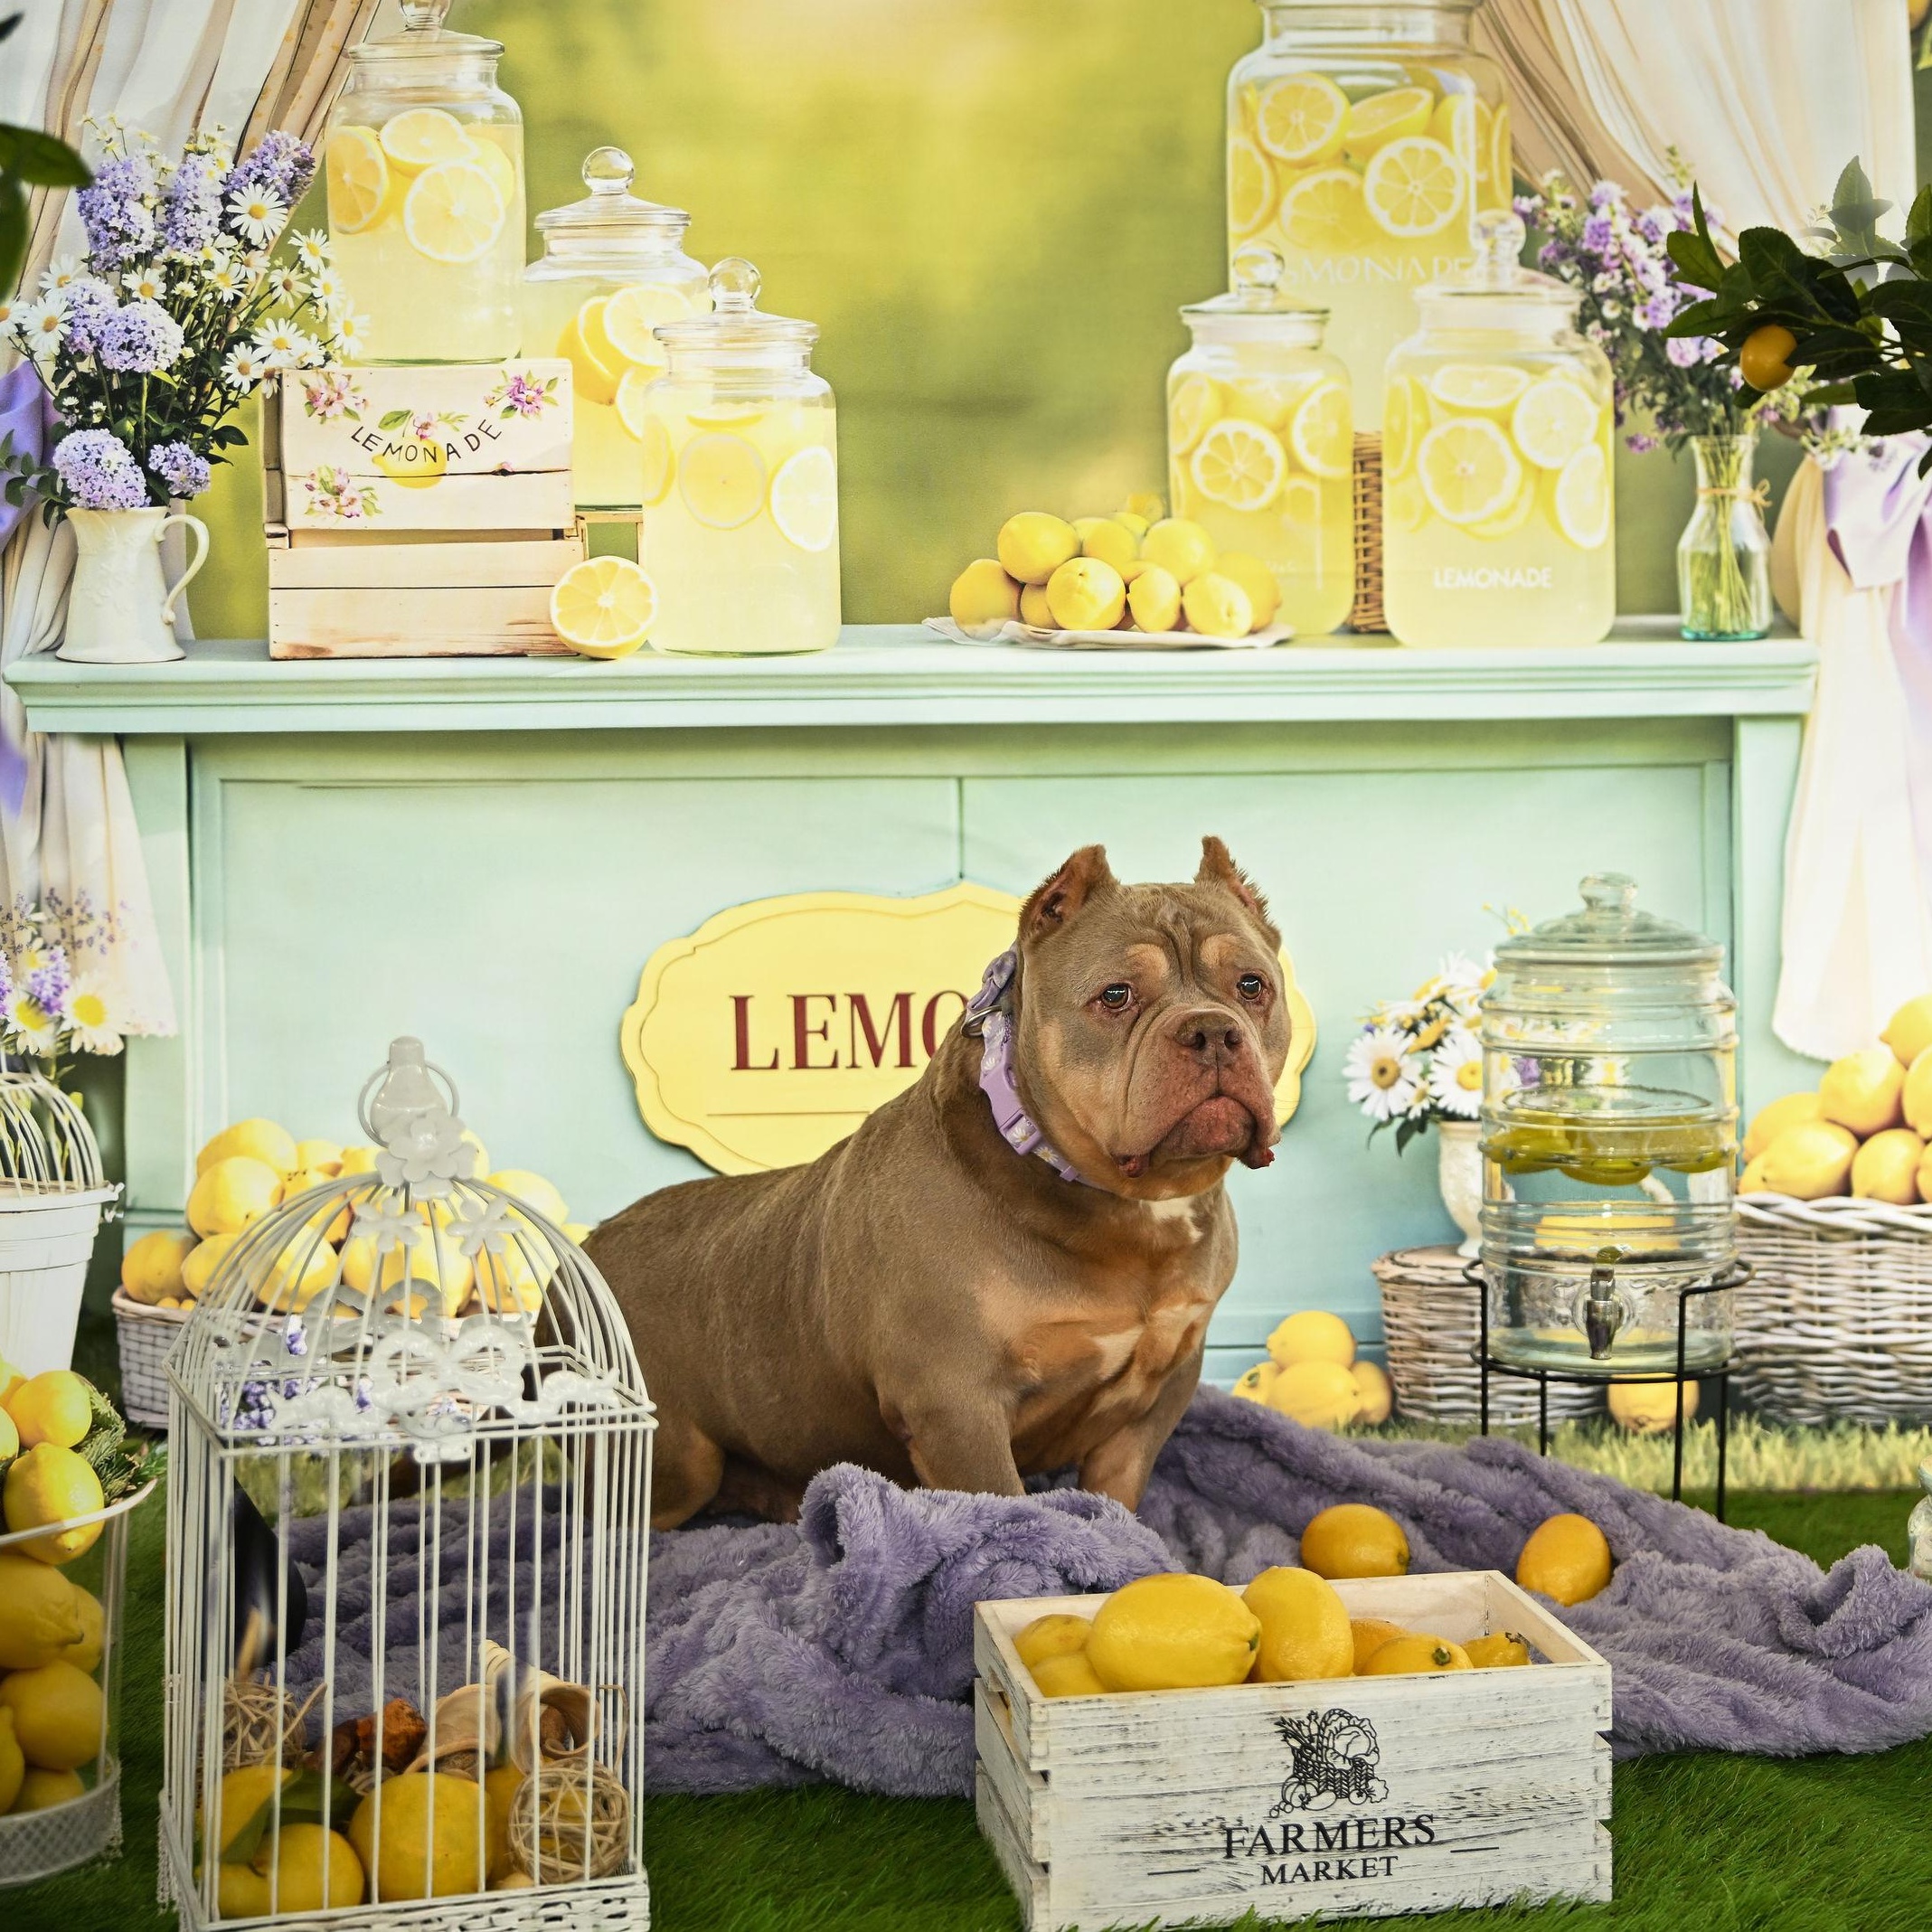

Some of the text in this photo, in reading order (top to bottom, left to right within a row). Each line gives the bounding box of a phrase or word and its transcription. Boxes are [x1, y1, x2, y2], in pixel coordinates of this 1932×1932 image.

[350, 419, 503, 463] LEMONADE
[1433, 566, 1553, 589] LEMONADE
[729, 990, 970, 1070] LEMO
[1223, 1814, 1436, 1859] FARMERS
[1260, 1855, 1400, 1886] MARKET
